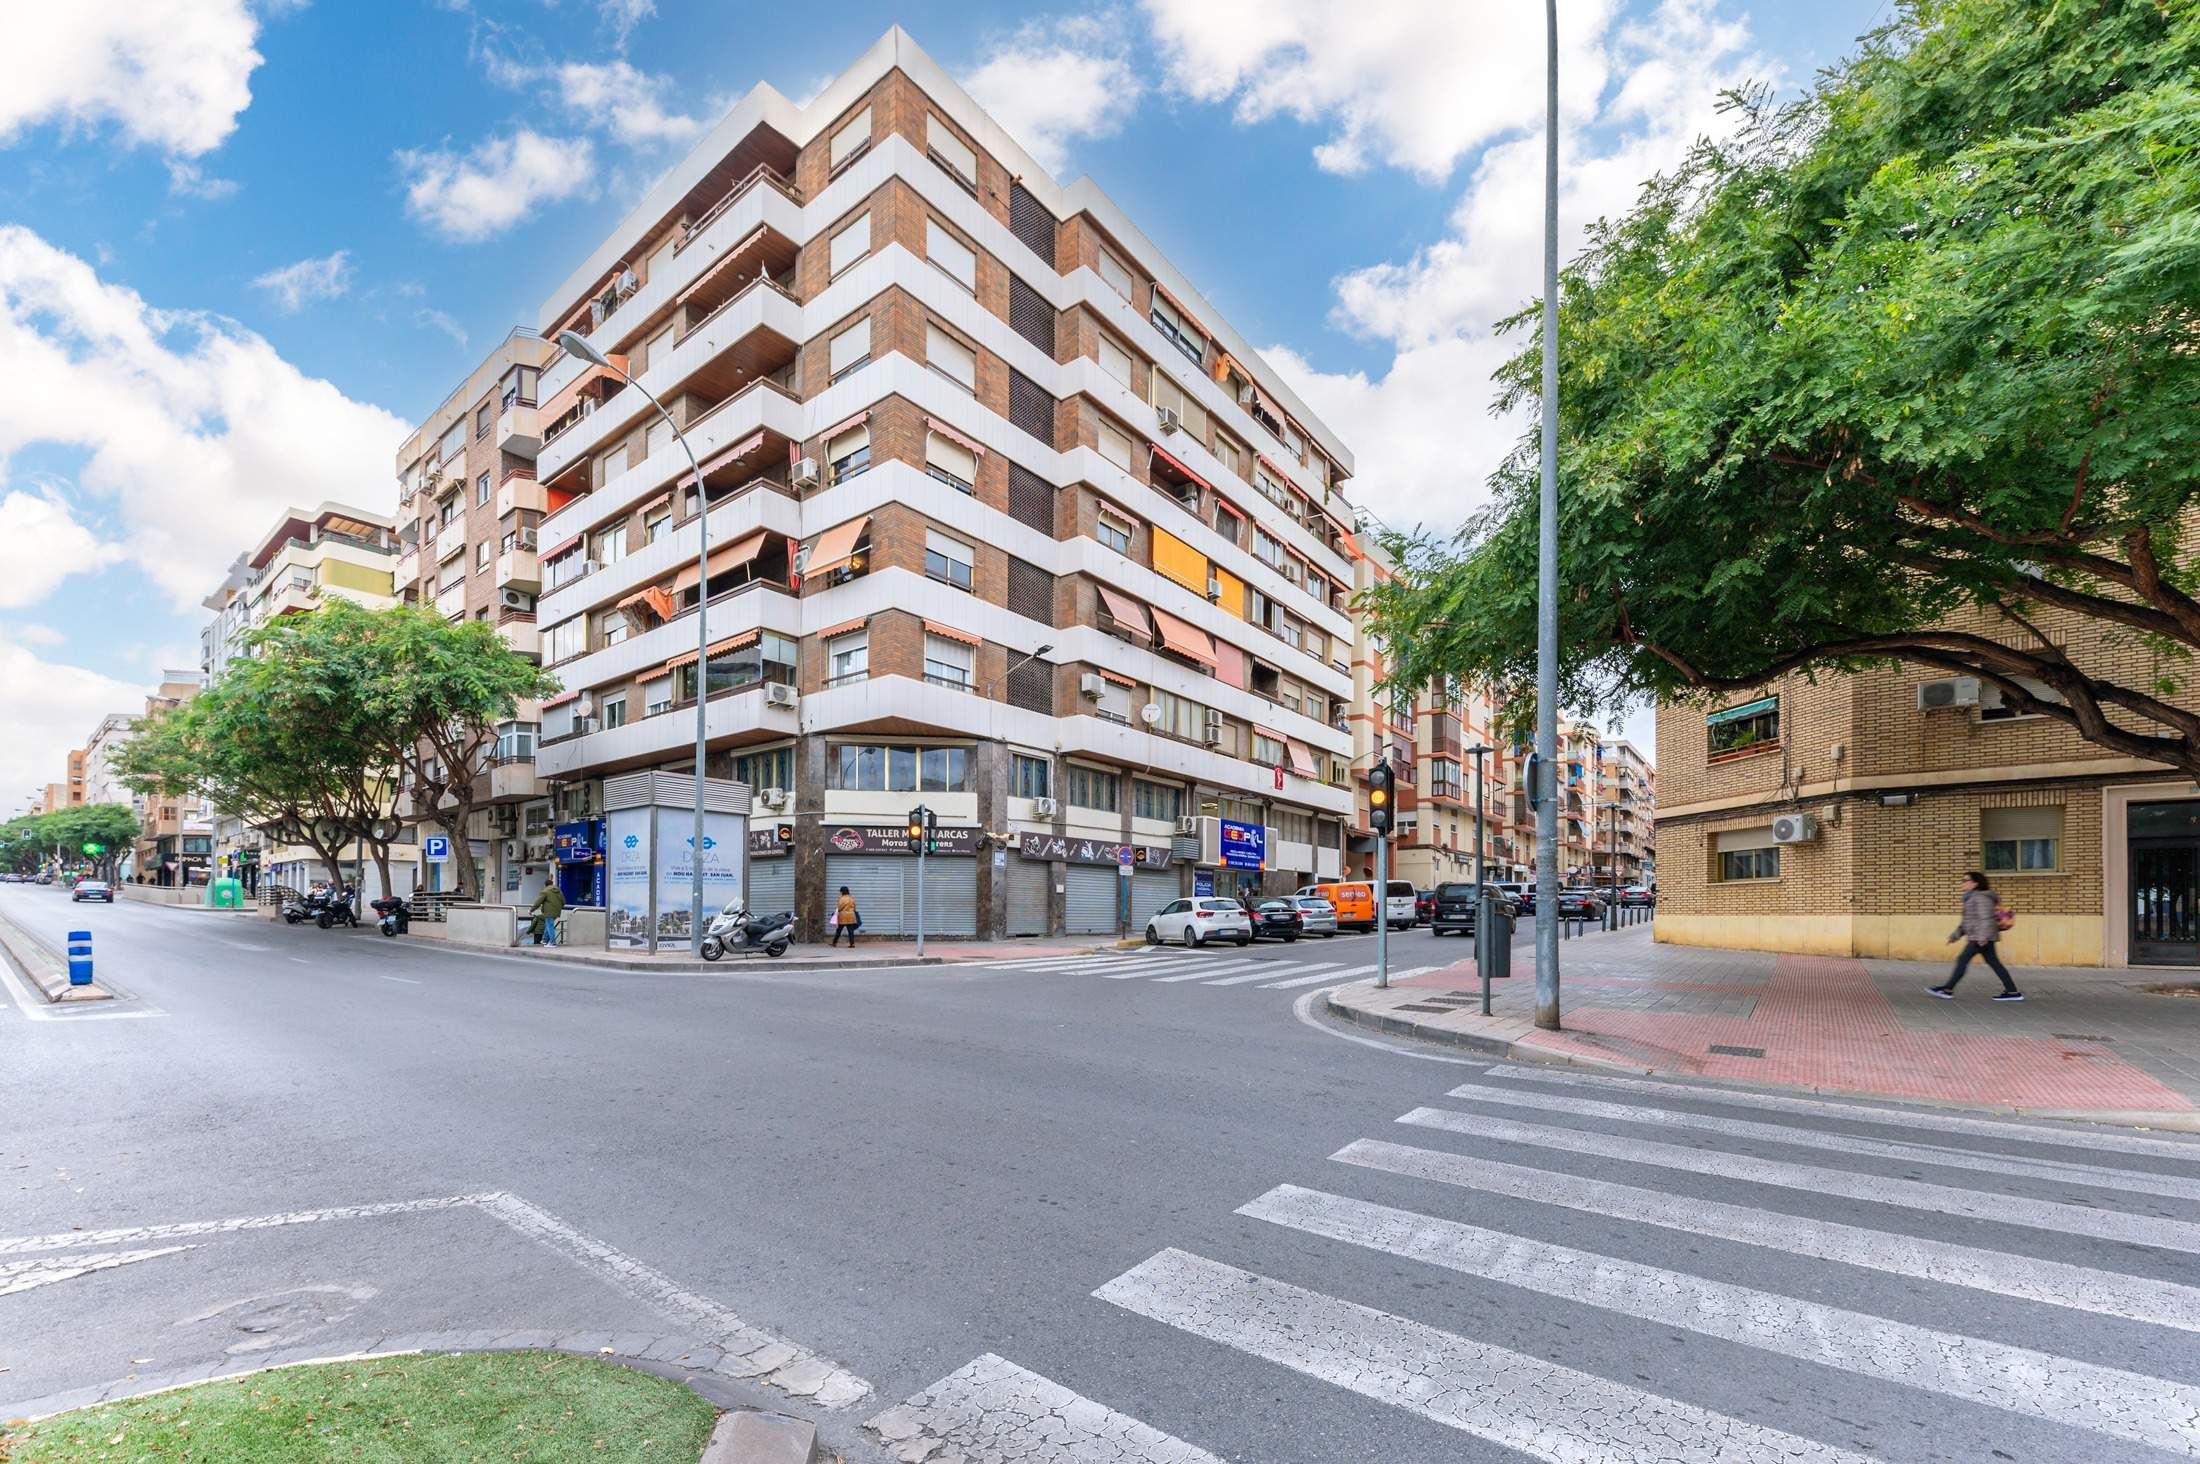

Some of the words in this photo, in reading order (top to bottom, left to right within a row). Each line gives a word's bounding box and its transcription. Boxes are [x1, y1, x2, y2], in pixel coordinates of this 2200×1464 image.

[866, 829, 900, 838] TALLER
[901, 829, 969, 840] MIARCAS
[430, 839, 444, 855] P
